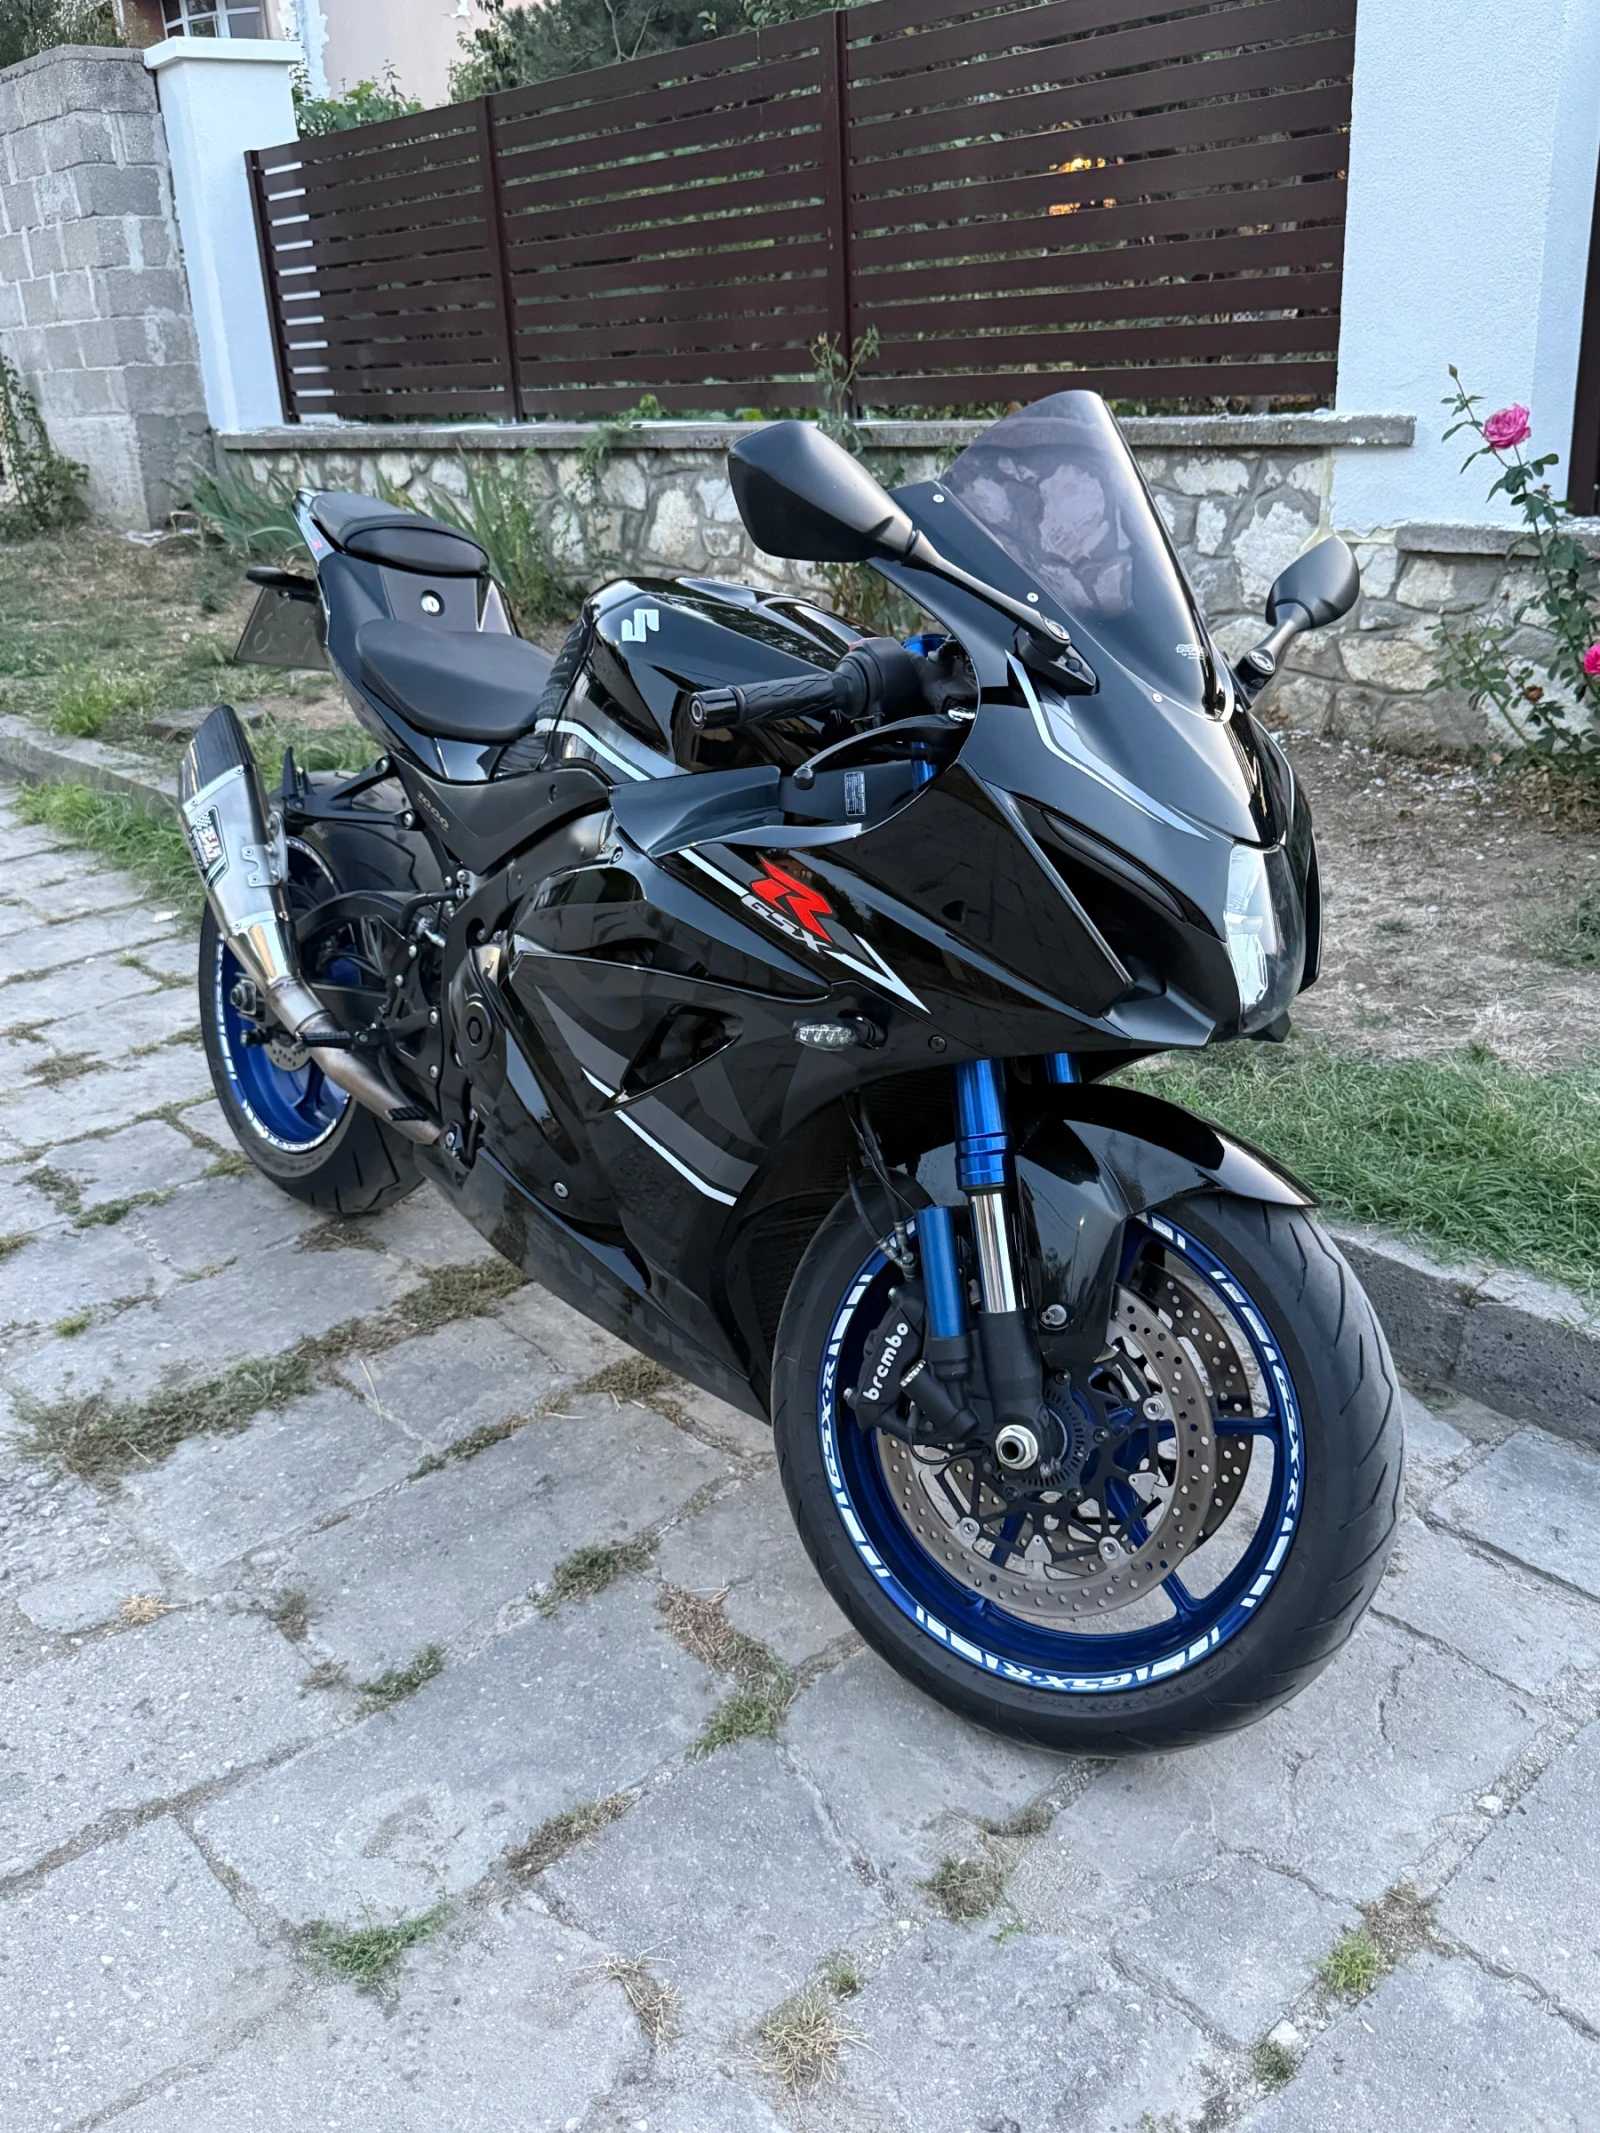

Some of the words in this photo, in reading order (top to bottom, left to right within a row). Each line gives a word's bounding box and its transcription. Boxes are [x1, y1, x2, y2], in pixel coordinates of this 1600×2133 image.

[416, 790, 449, 831] 1000
[740, 895, 833, 953] GSX
[751, 856, 833, 944] R
[862, 1322, 909, 1401] brembo
